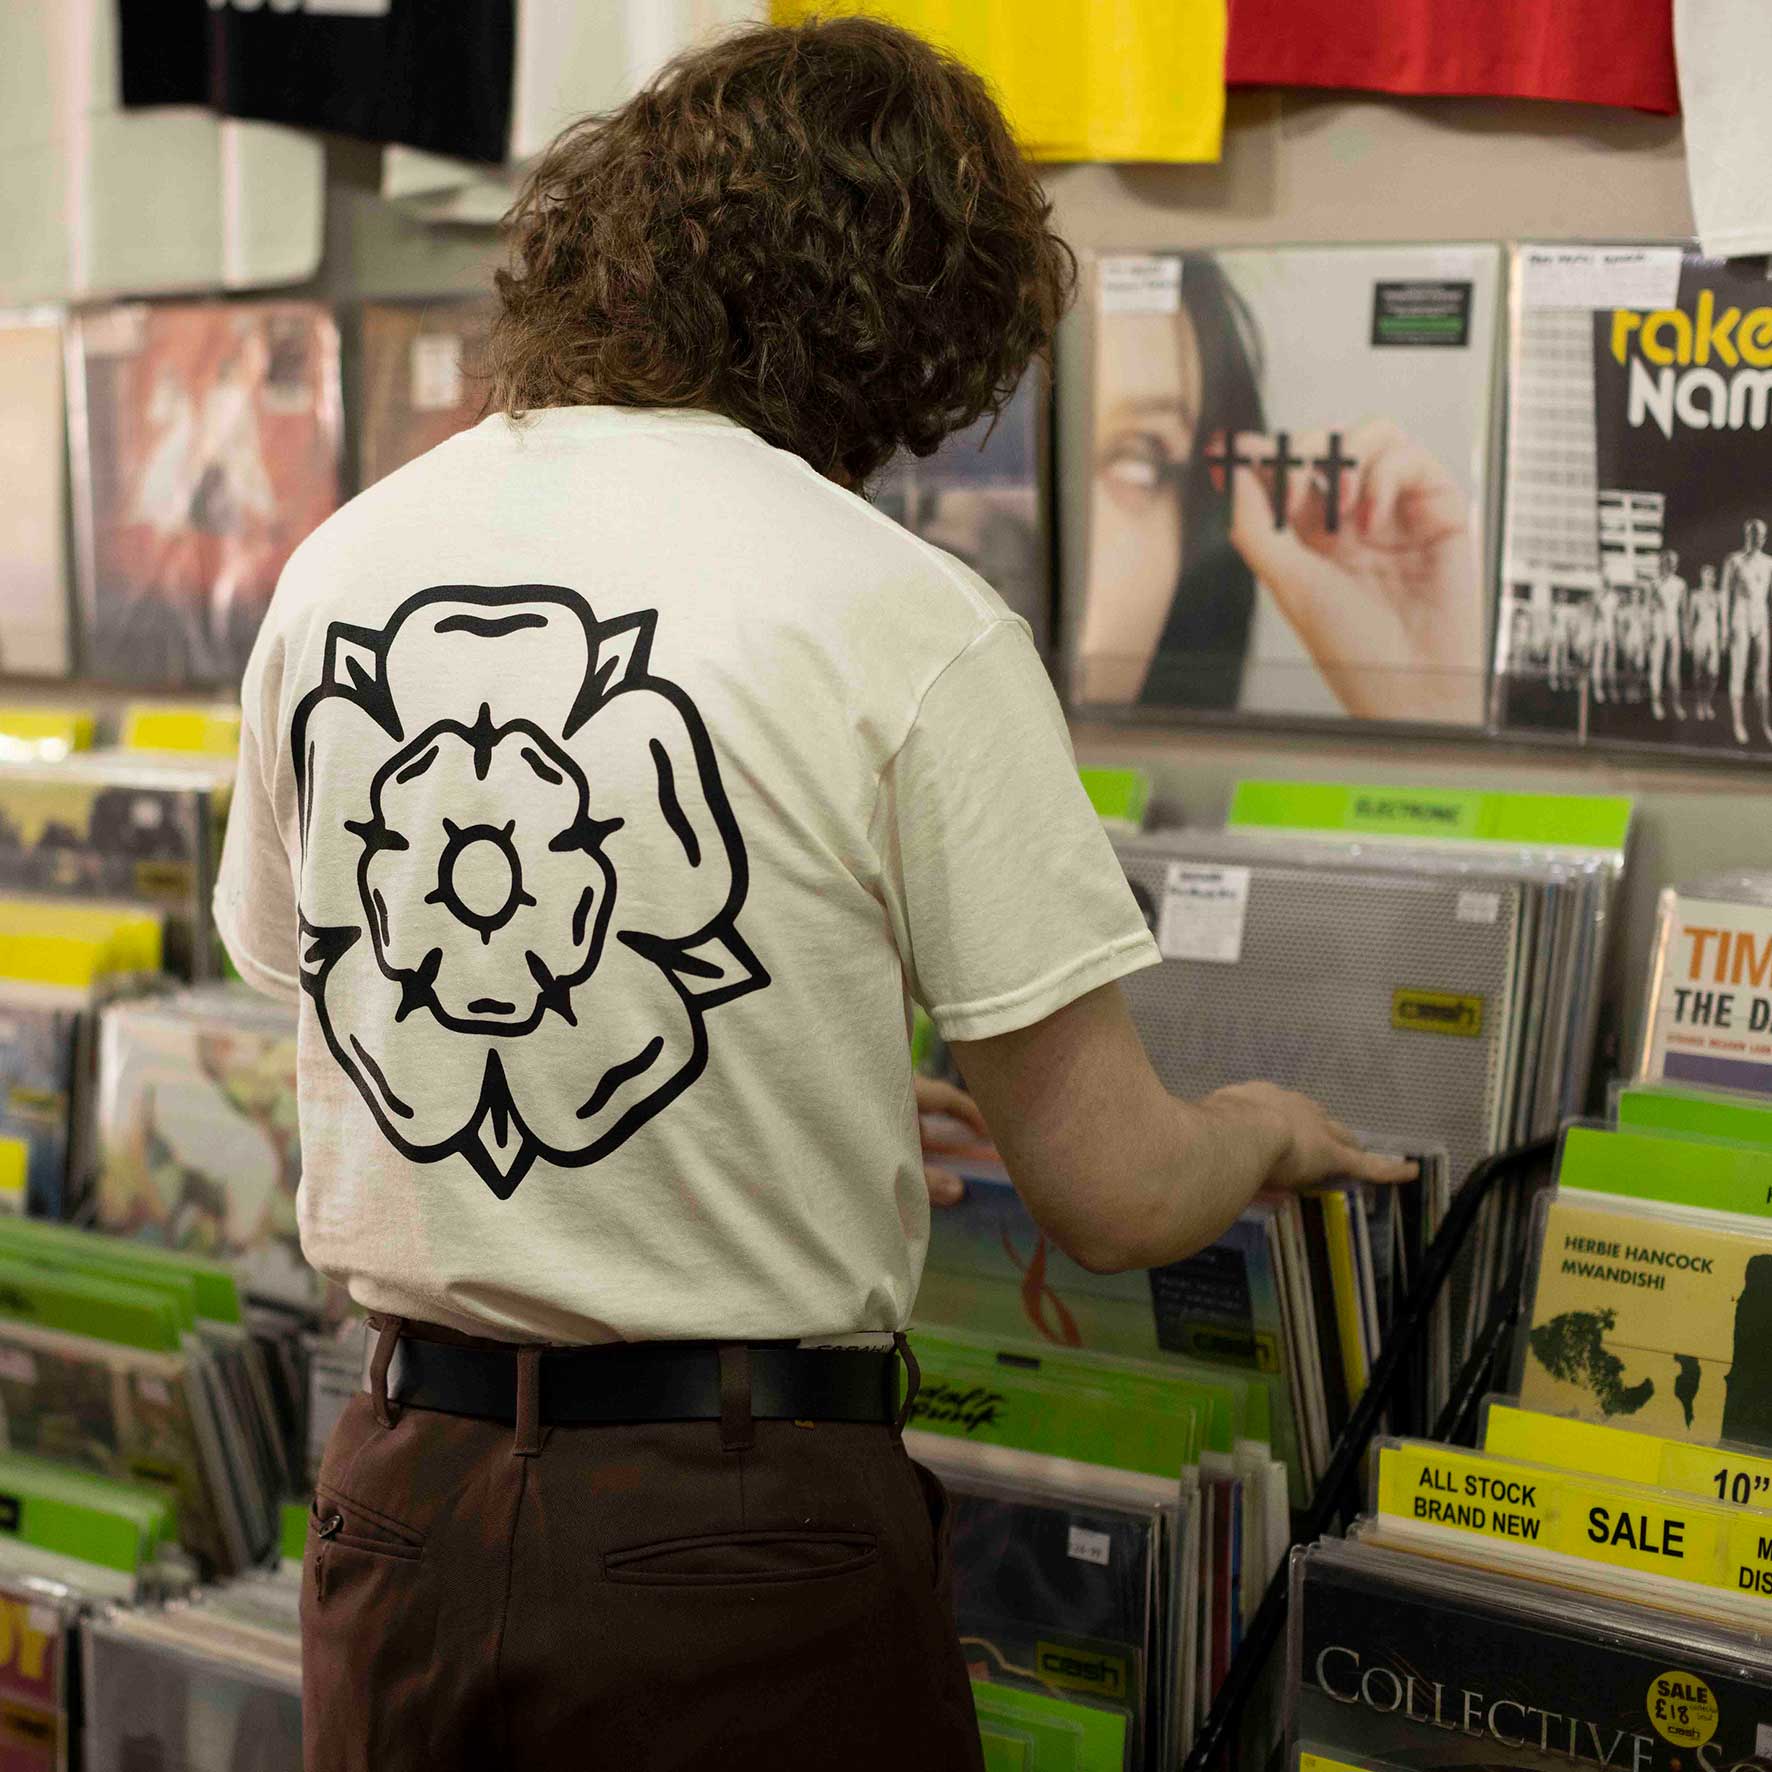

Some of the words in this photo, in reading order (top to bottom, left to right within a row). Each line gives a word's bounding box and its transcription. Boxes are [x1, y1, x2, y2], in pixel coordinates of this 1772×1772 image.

[1674, 988, 1736, 1028] THE
[1748, 997, 1772, 1035] D
[1561, 1259, 1665, 1291] MWANDISHI
[1564, 1235, 1620, 1258] HERBIE
[1625, 1246, 1715, 1274] HANCOCK
[1419, 1467, 1458, 1493] ALL
[1464, 1475, 1536, 1508] STOCK
[1414, 1496, 1486, 1529] BRAND
[1492, 1511, 1541, 1540] NEW
[1587, 1506, 1685, 1558] SALE
[1657, 1680, 1708, 1704] SALE
